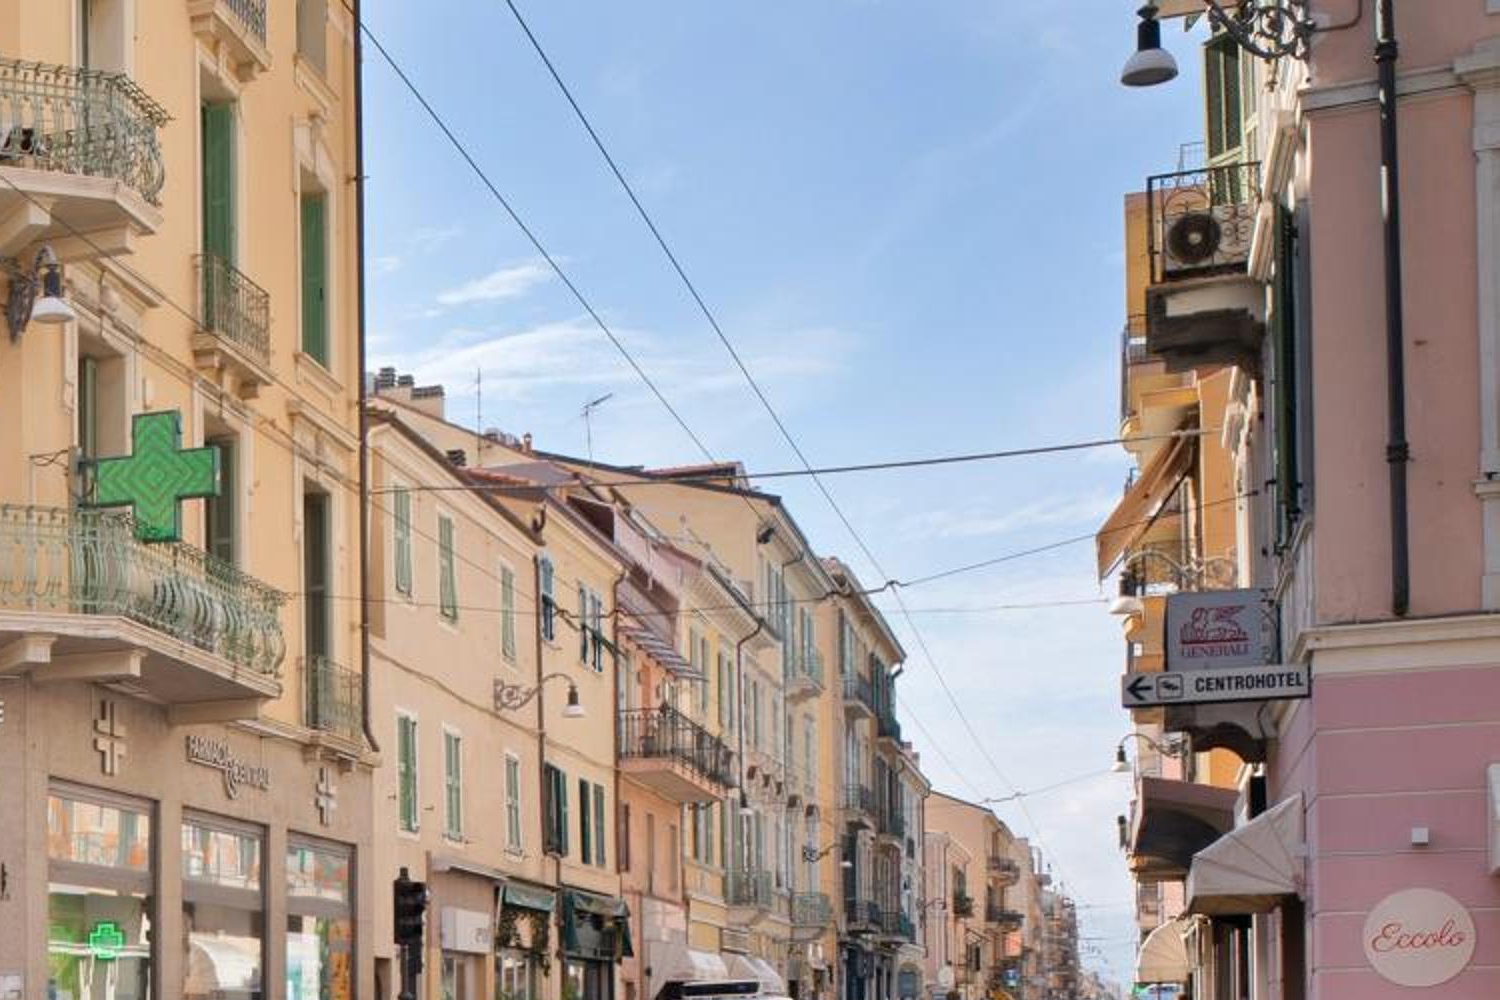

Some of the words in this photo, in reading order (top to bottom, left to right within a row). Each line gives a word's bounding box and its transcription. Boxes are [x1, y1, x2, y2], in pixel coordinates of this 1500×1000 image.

[1181, 643, 1250, 659] GENERALI
[1194, 671, 1304, 693] CENTROHOTEL
[1371, 917, 1466, 953] Eccolo
